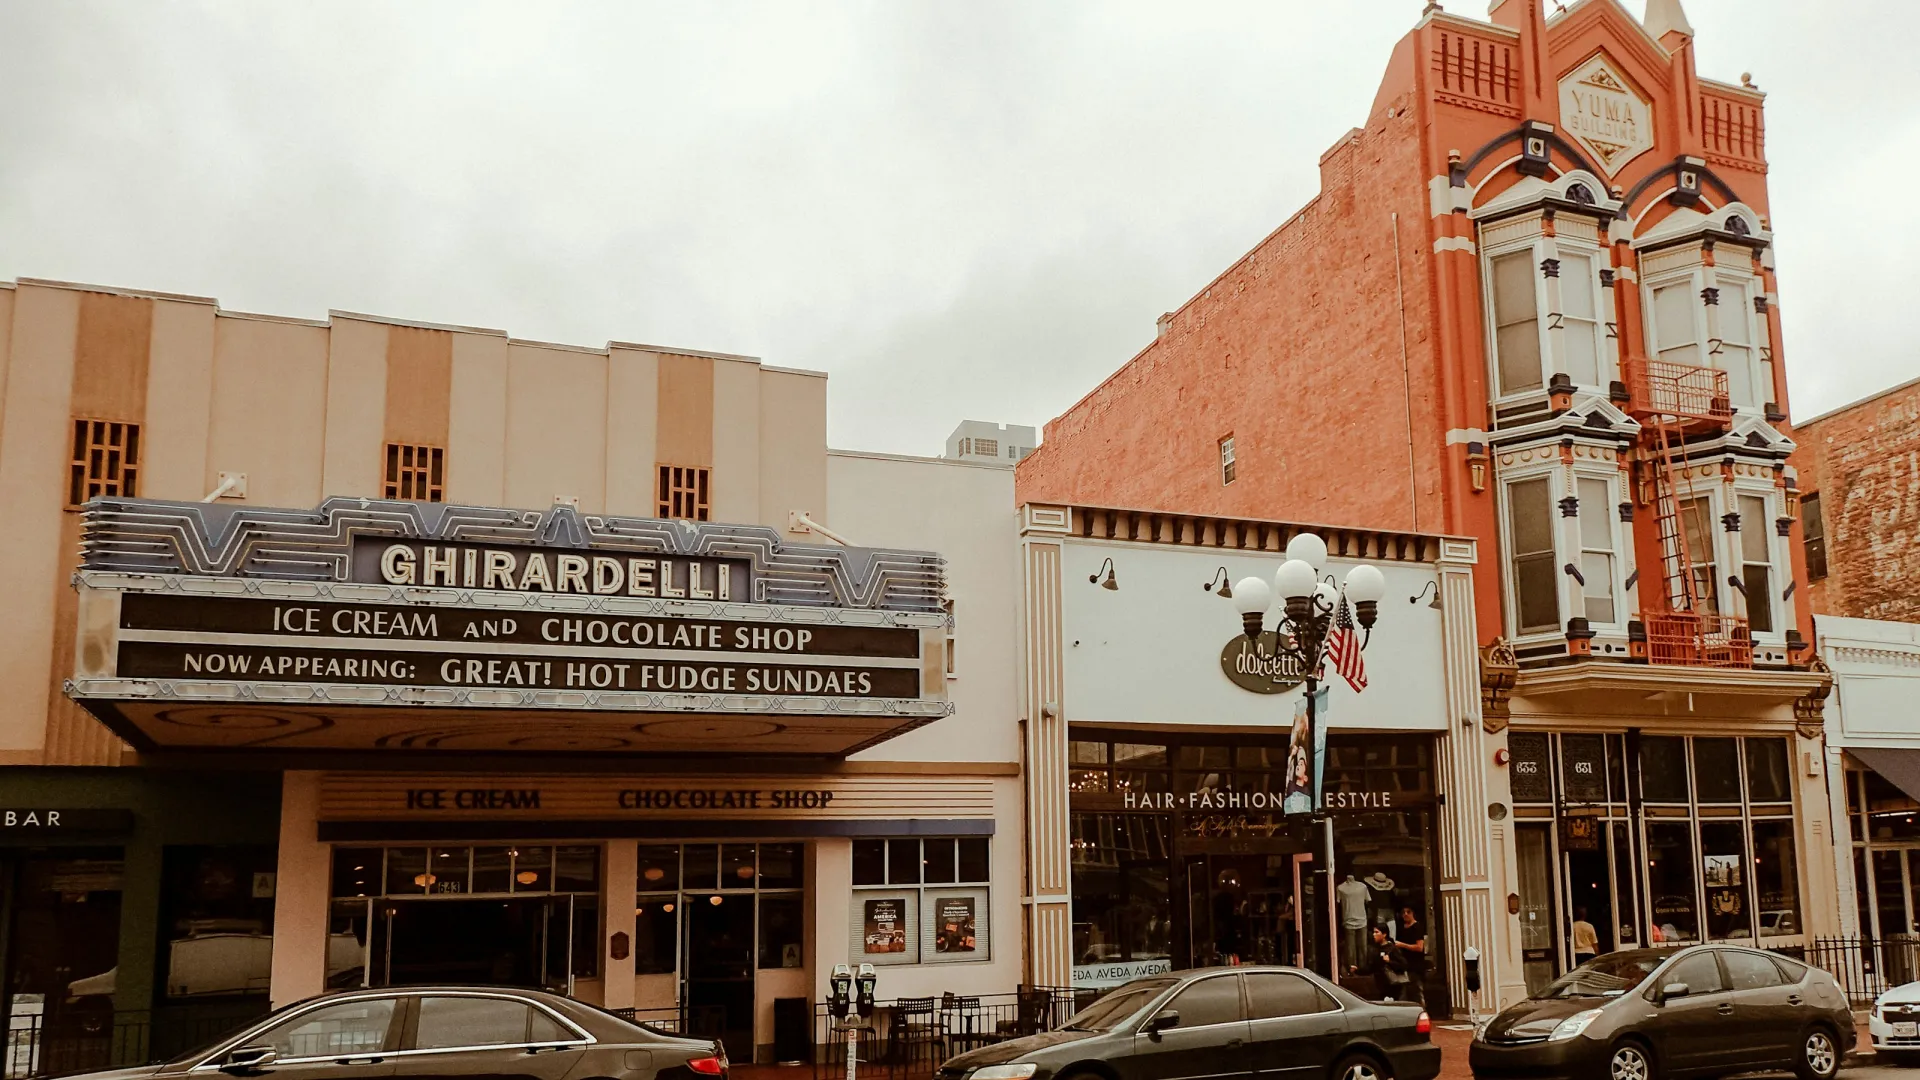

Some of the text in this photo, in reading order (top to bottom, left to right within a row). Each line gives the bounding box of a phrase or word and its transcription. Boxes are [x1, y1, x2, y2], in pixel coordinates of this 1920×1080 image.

[1571, 89, 1636, 126] YUMA
[380, 544, 731, 601] GHIRARDELLI
[273, 607, 813, 651] ICE CREAM AND CHOCOLATE SHOP
[184, 653, 872, 695] NOW APPEARING: GREAT! HOT FUDGE SUNDAES
[1516, 761, 1537, 774] 633
[1574, 762, 1593, 774] 631
[406, 789, 834, 809] ICE CREAM CHOCOLATE SHOP
[1124, 792, 1392, 809] HAIR FASHION ESTYLE
[4, 811, 62, 827] BAR
[439, 881, 460, 894] 643
[786, 946, 797, 959] A
[1073, 964, 1168, 981] EDA AVEDA AVEDA
